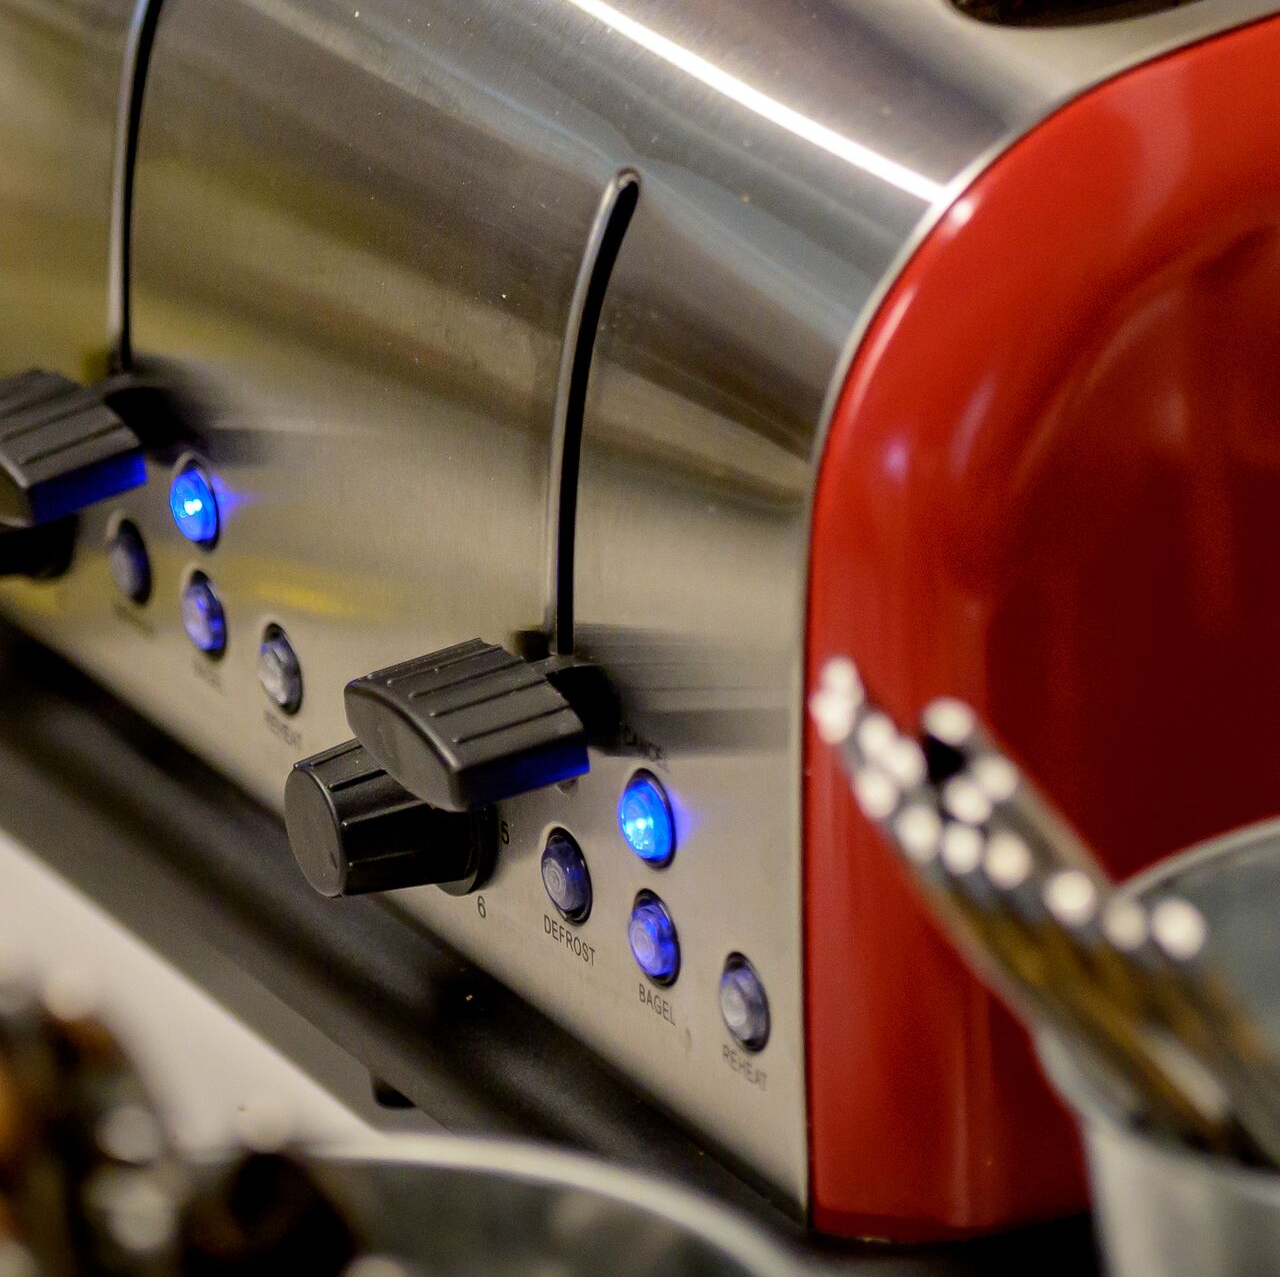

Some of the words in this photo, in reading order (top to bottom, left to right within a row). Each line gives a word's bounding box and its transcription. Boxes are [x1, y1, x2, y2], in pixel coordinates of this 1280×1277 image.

[501, 821, 510, 845] 5
[477, 895, 486, 919] 6
[543, 914, 596, 966] DEFROST
[638, 982, 677, 1027] BAGEL
[722, 1043, 768, 1093] REHEAT
